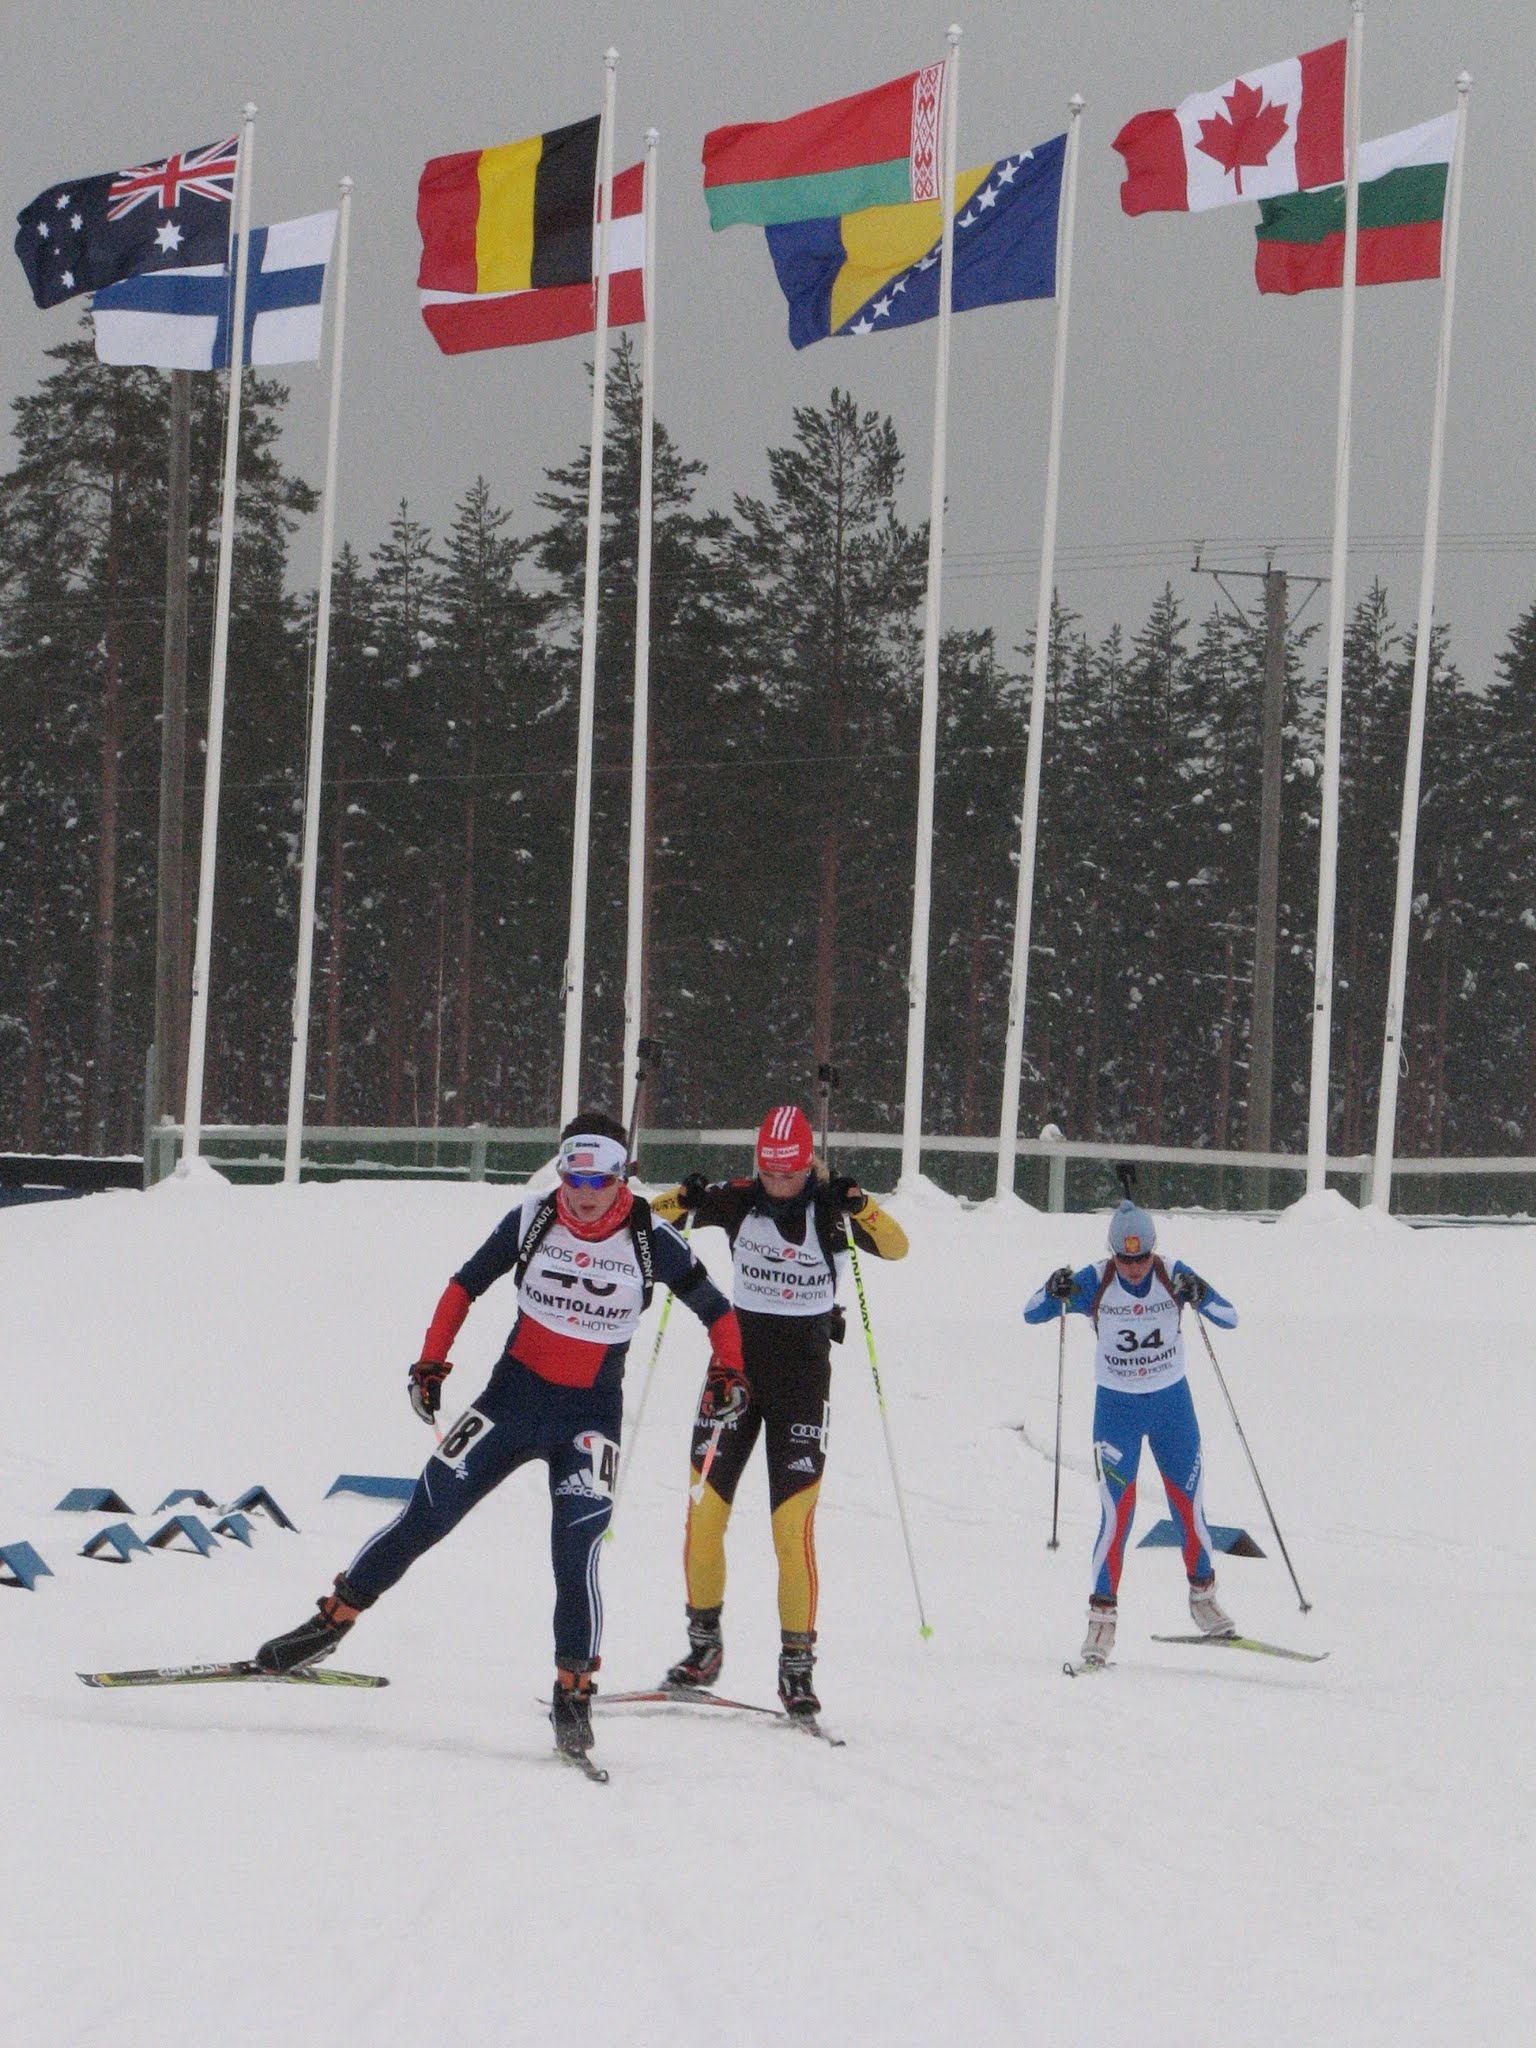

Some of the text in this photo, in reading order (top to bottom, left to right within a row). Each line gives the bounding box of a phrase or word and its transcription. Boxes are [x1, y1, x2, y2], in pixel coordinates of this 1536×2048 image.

[536, 1241, 574, 1263] OKOS
[739, 1237, 780, 1258] SOKOS
[740, 1263, 834, 1287] KONTIOLAHT
[1116, 1328, 1164, 1353] 34
[1104, 1346, 1177, 1367] KONTIOLAHTI
[438, 1411, 484, 1459] 8
